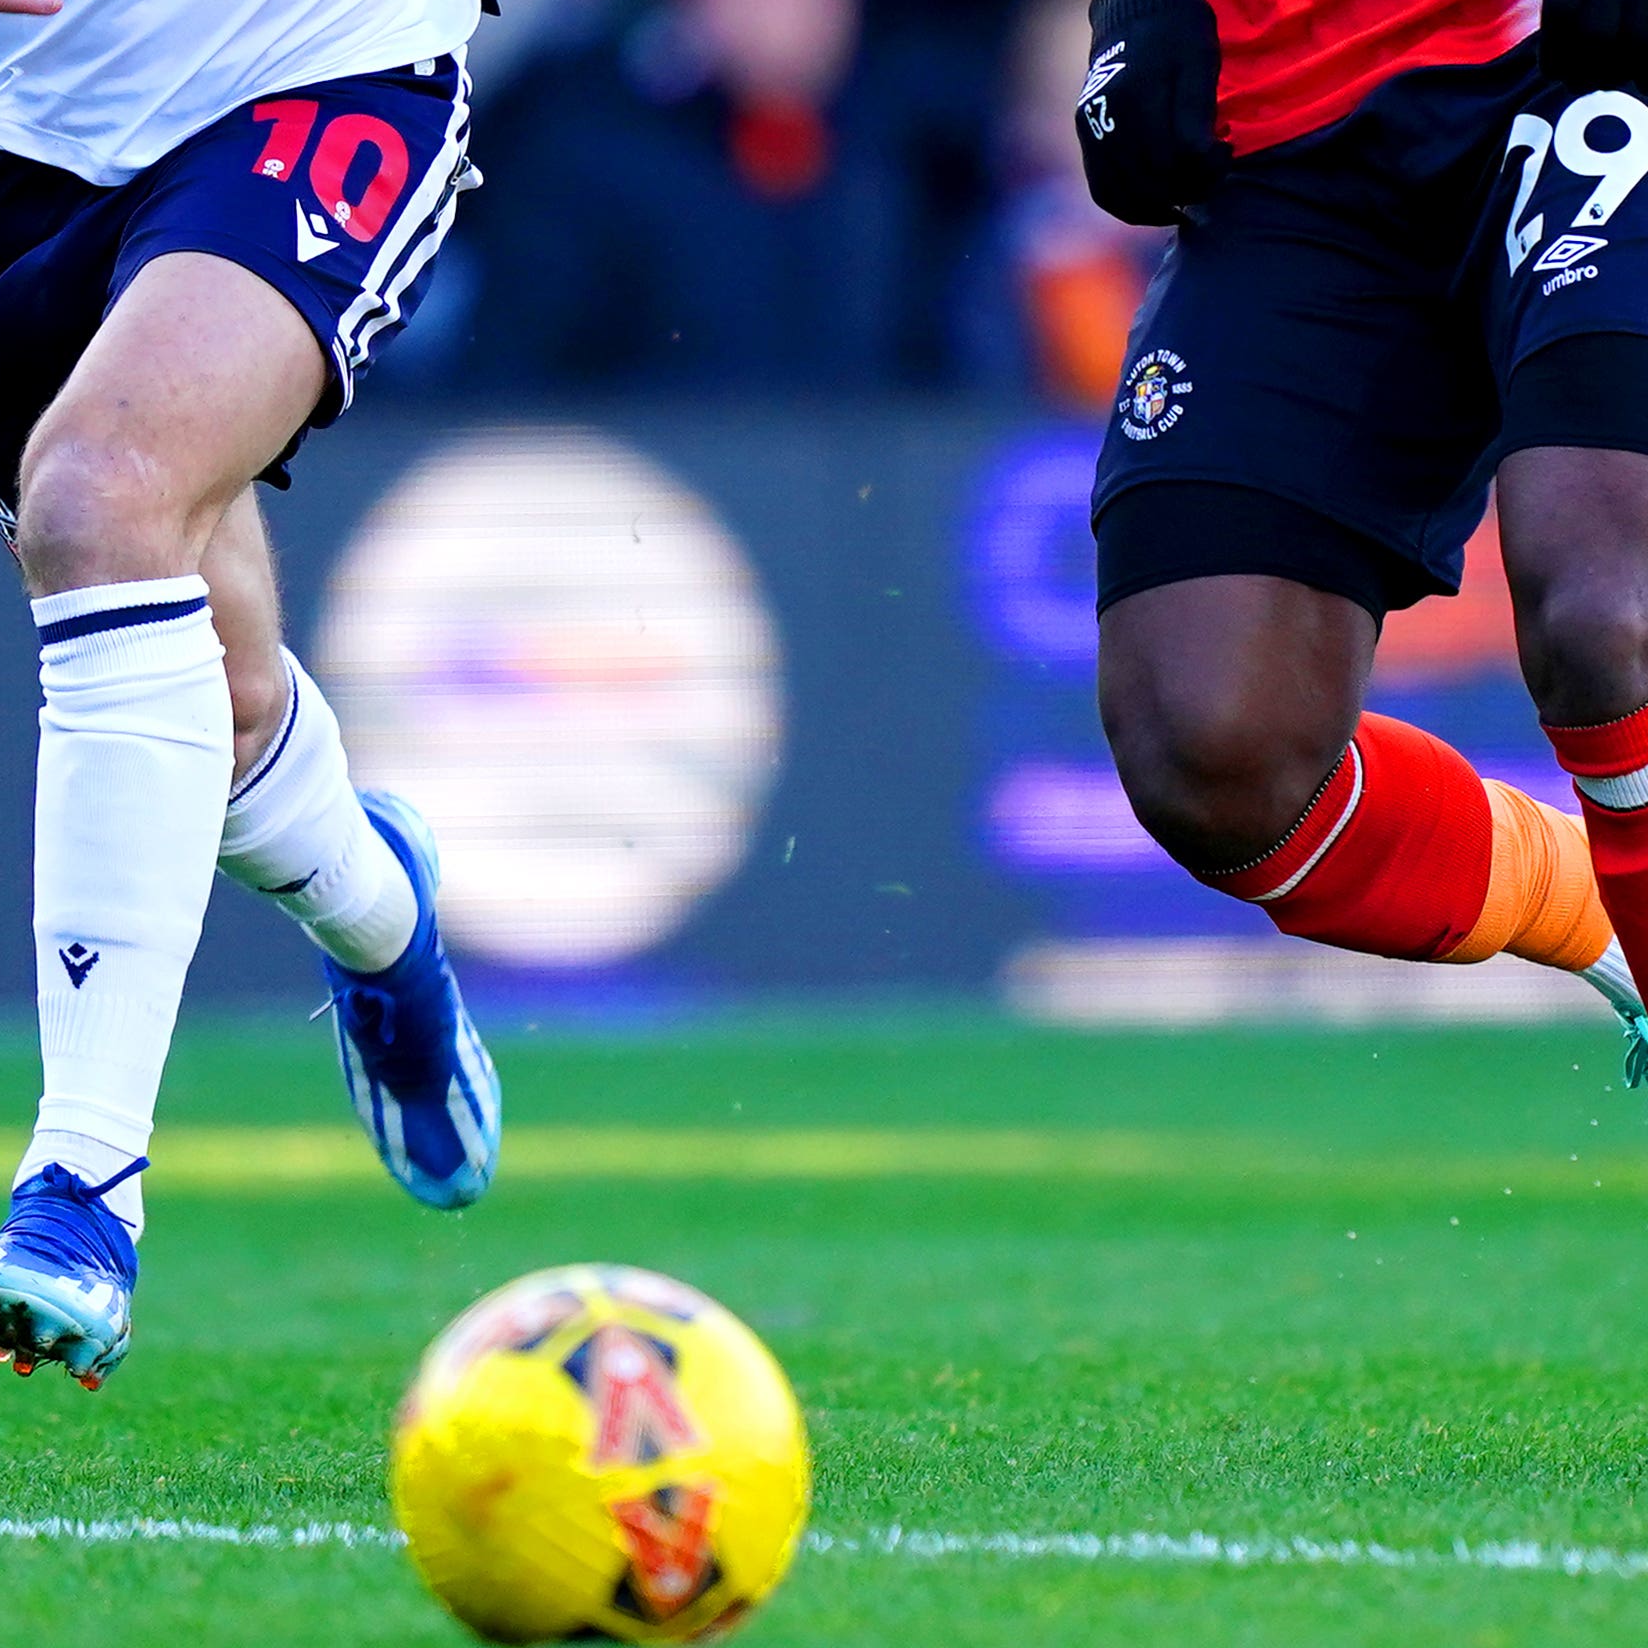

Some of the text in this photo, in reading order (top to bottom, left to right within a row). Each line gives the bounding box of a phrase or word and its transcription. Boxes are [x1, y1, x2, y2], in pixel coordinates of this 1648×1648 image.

[252, 99, 410, 243] 10
[1542, 265, 1598, 296] umbro
[1157, 348, 1187, 374] TOWN
[1158, 403, 1184, 433] CLUB
